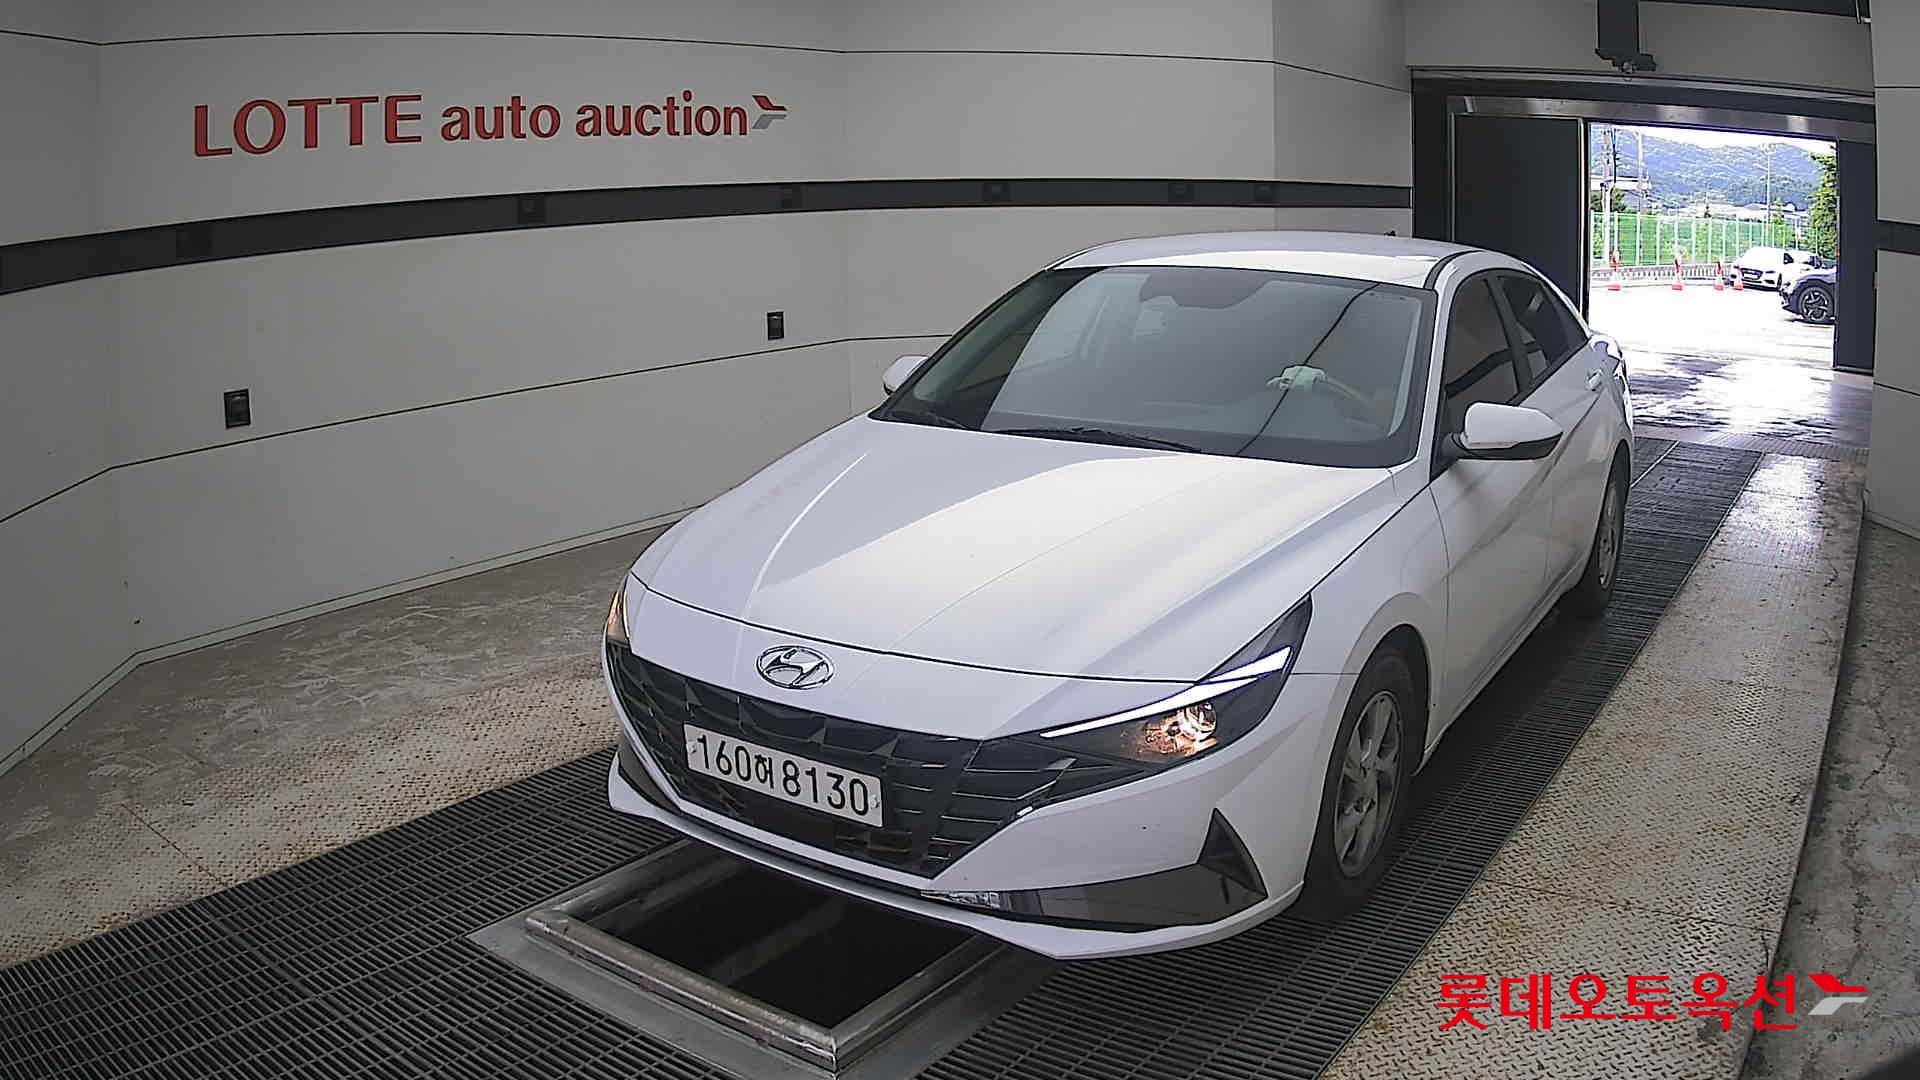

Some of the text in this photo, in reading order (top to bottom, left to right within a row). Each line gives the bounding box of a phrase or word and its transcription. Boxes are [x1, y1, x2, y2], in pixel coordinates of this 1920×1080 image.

[194, 90, 748, 156] LOTTE auto auction
